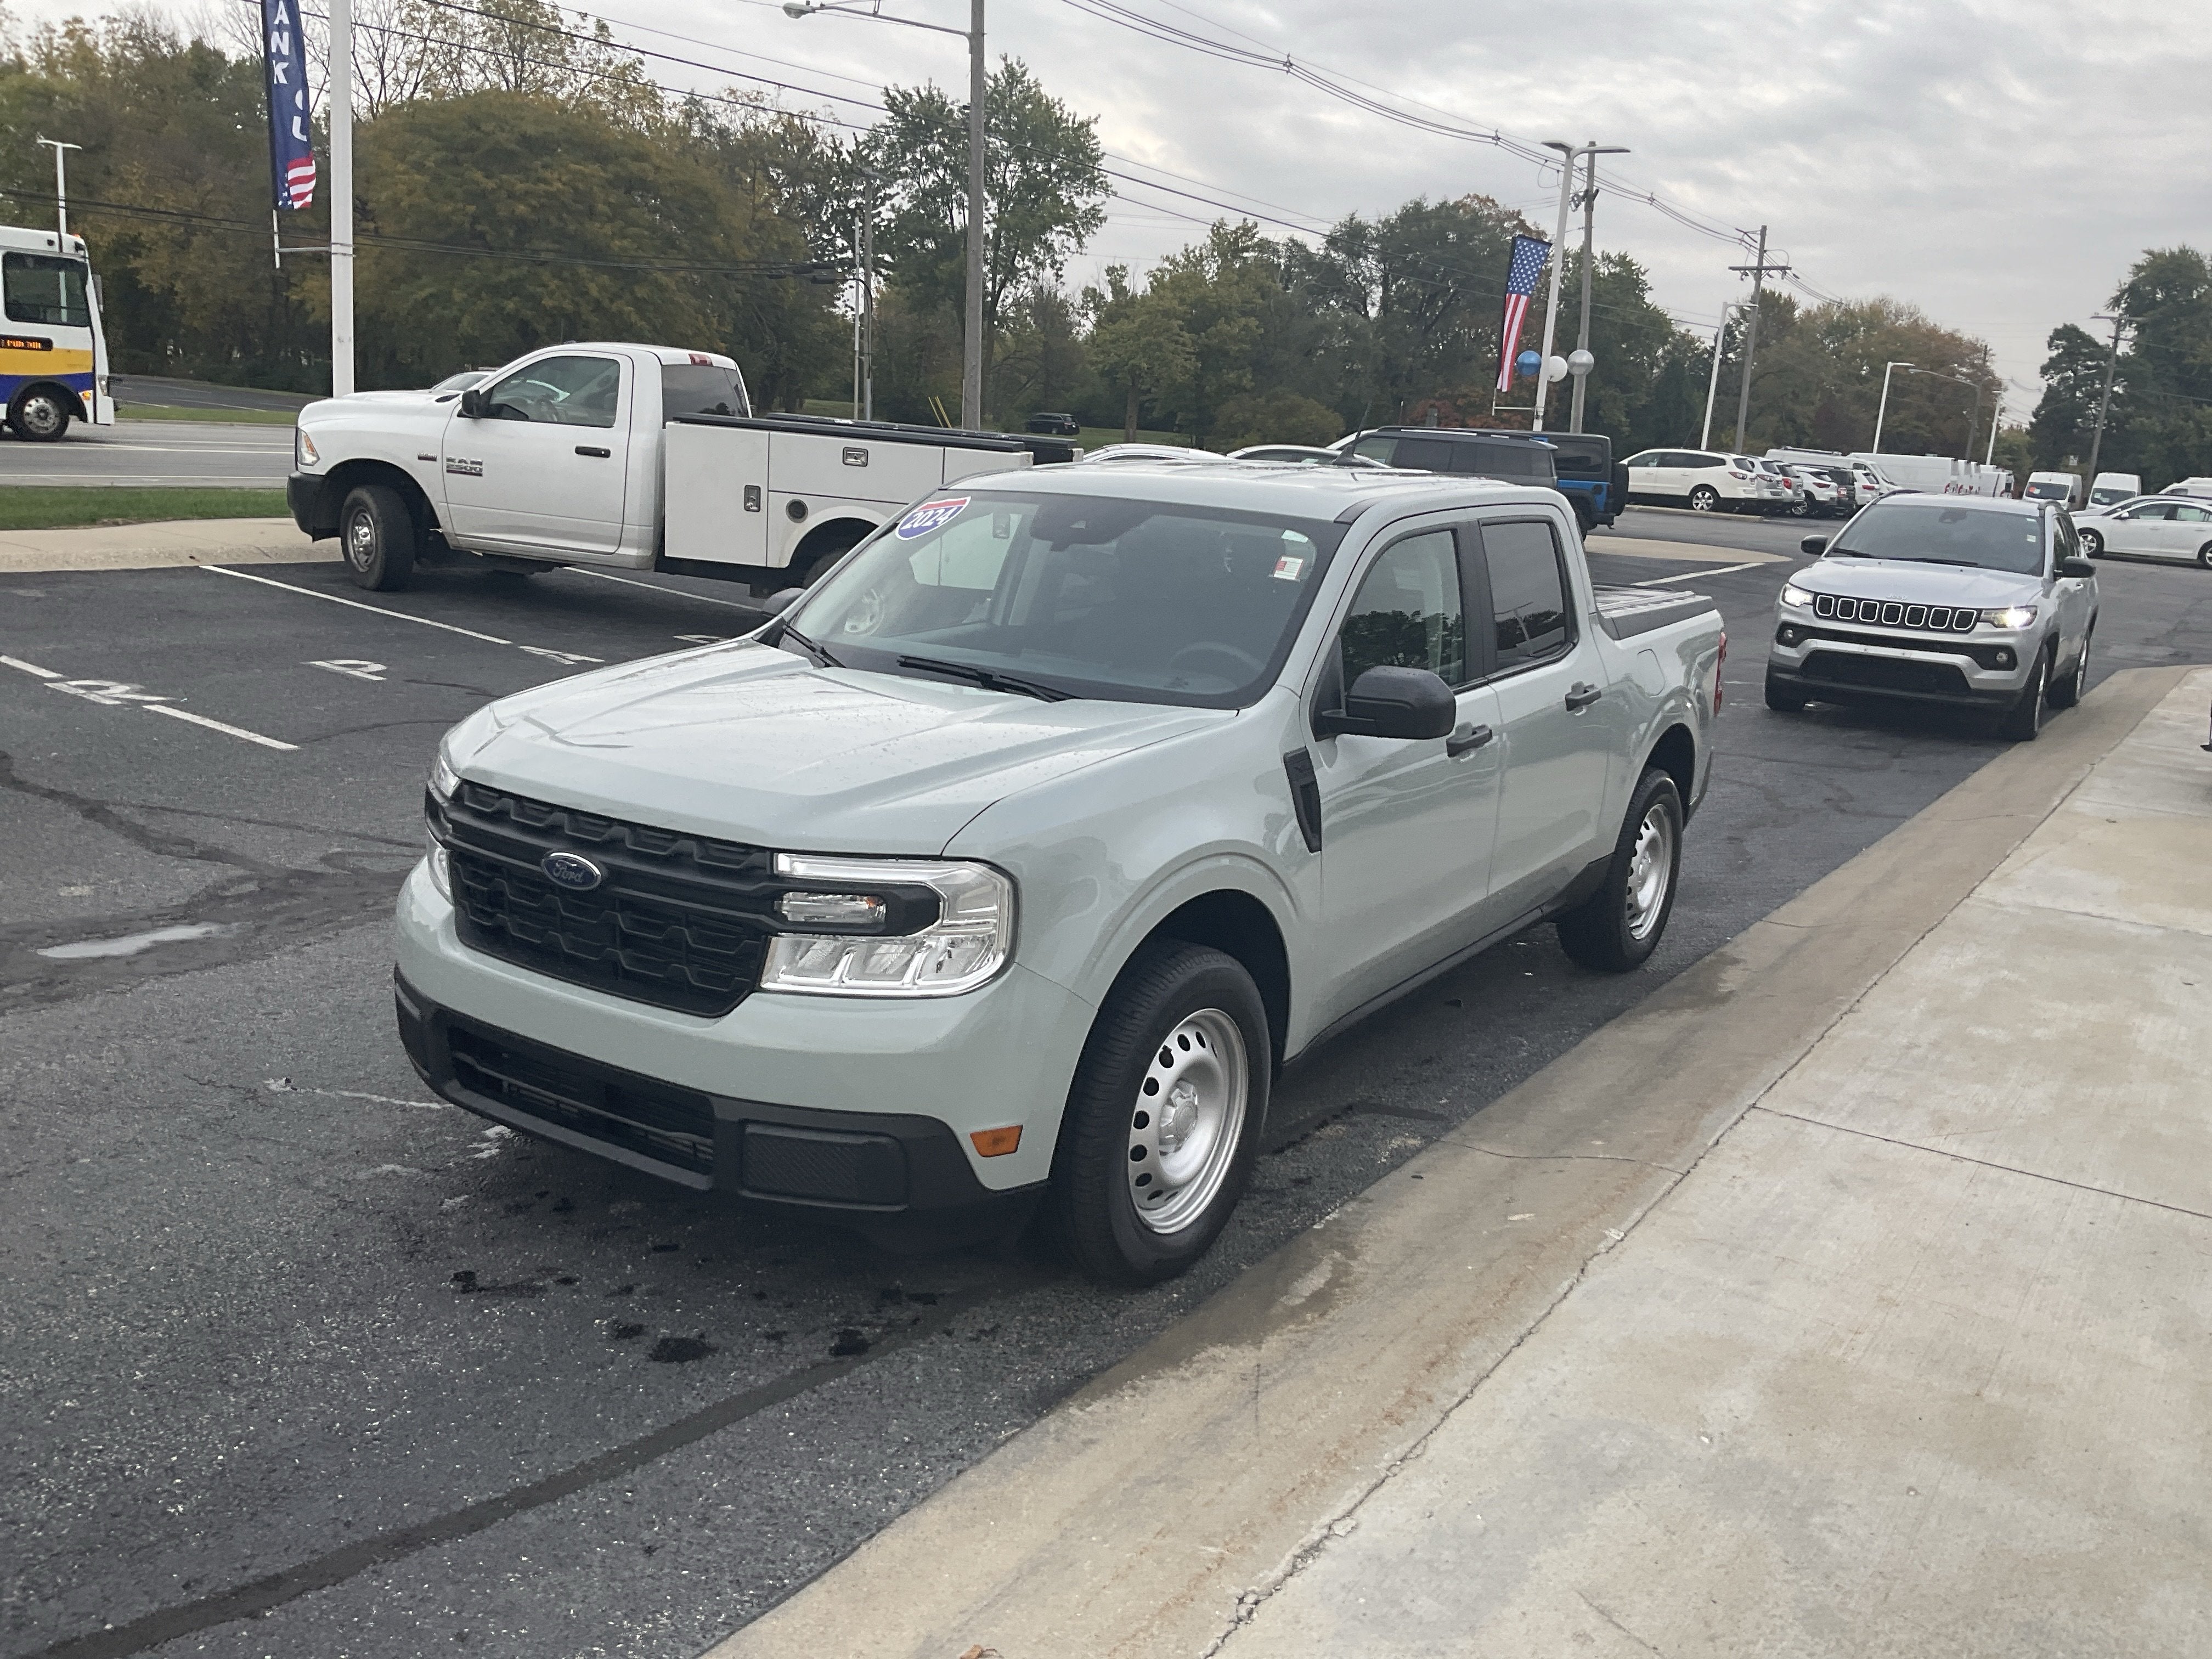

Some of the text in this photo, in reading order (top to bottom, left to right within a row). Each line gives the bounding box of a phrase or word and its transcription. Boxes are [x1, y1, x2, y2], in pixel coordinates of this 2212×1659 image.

[445, 456, 483, 466] RAM
[446, 463, 483, 473] 2500
[900, 507, 958, 530] 2024
